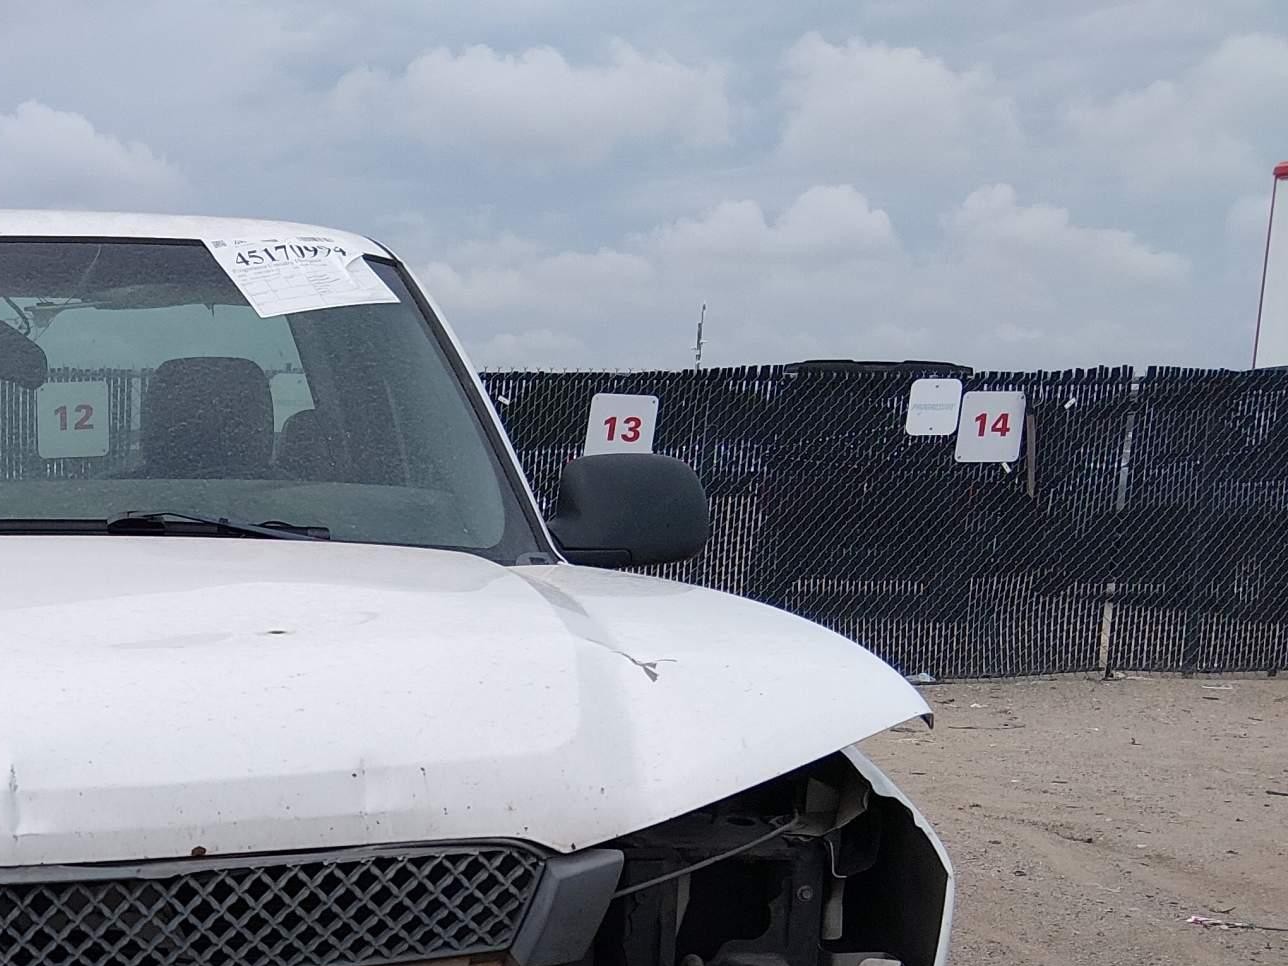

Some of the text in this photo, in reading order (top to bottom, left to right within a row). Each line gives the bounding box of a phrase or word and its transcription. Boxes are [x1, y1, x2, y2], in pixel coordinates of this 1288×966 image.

[54, 404, 94, 431] 12
[604, 416, 642, 443] 13
[974, 412, 1011, 437] 14
